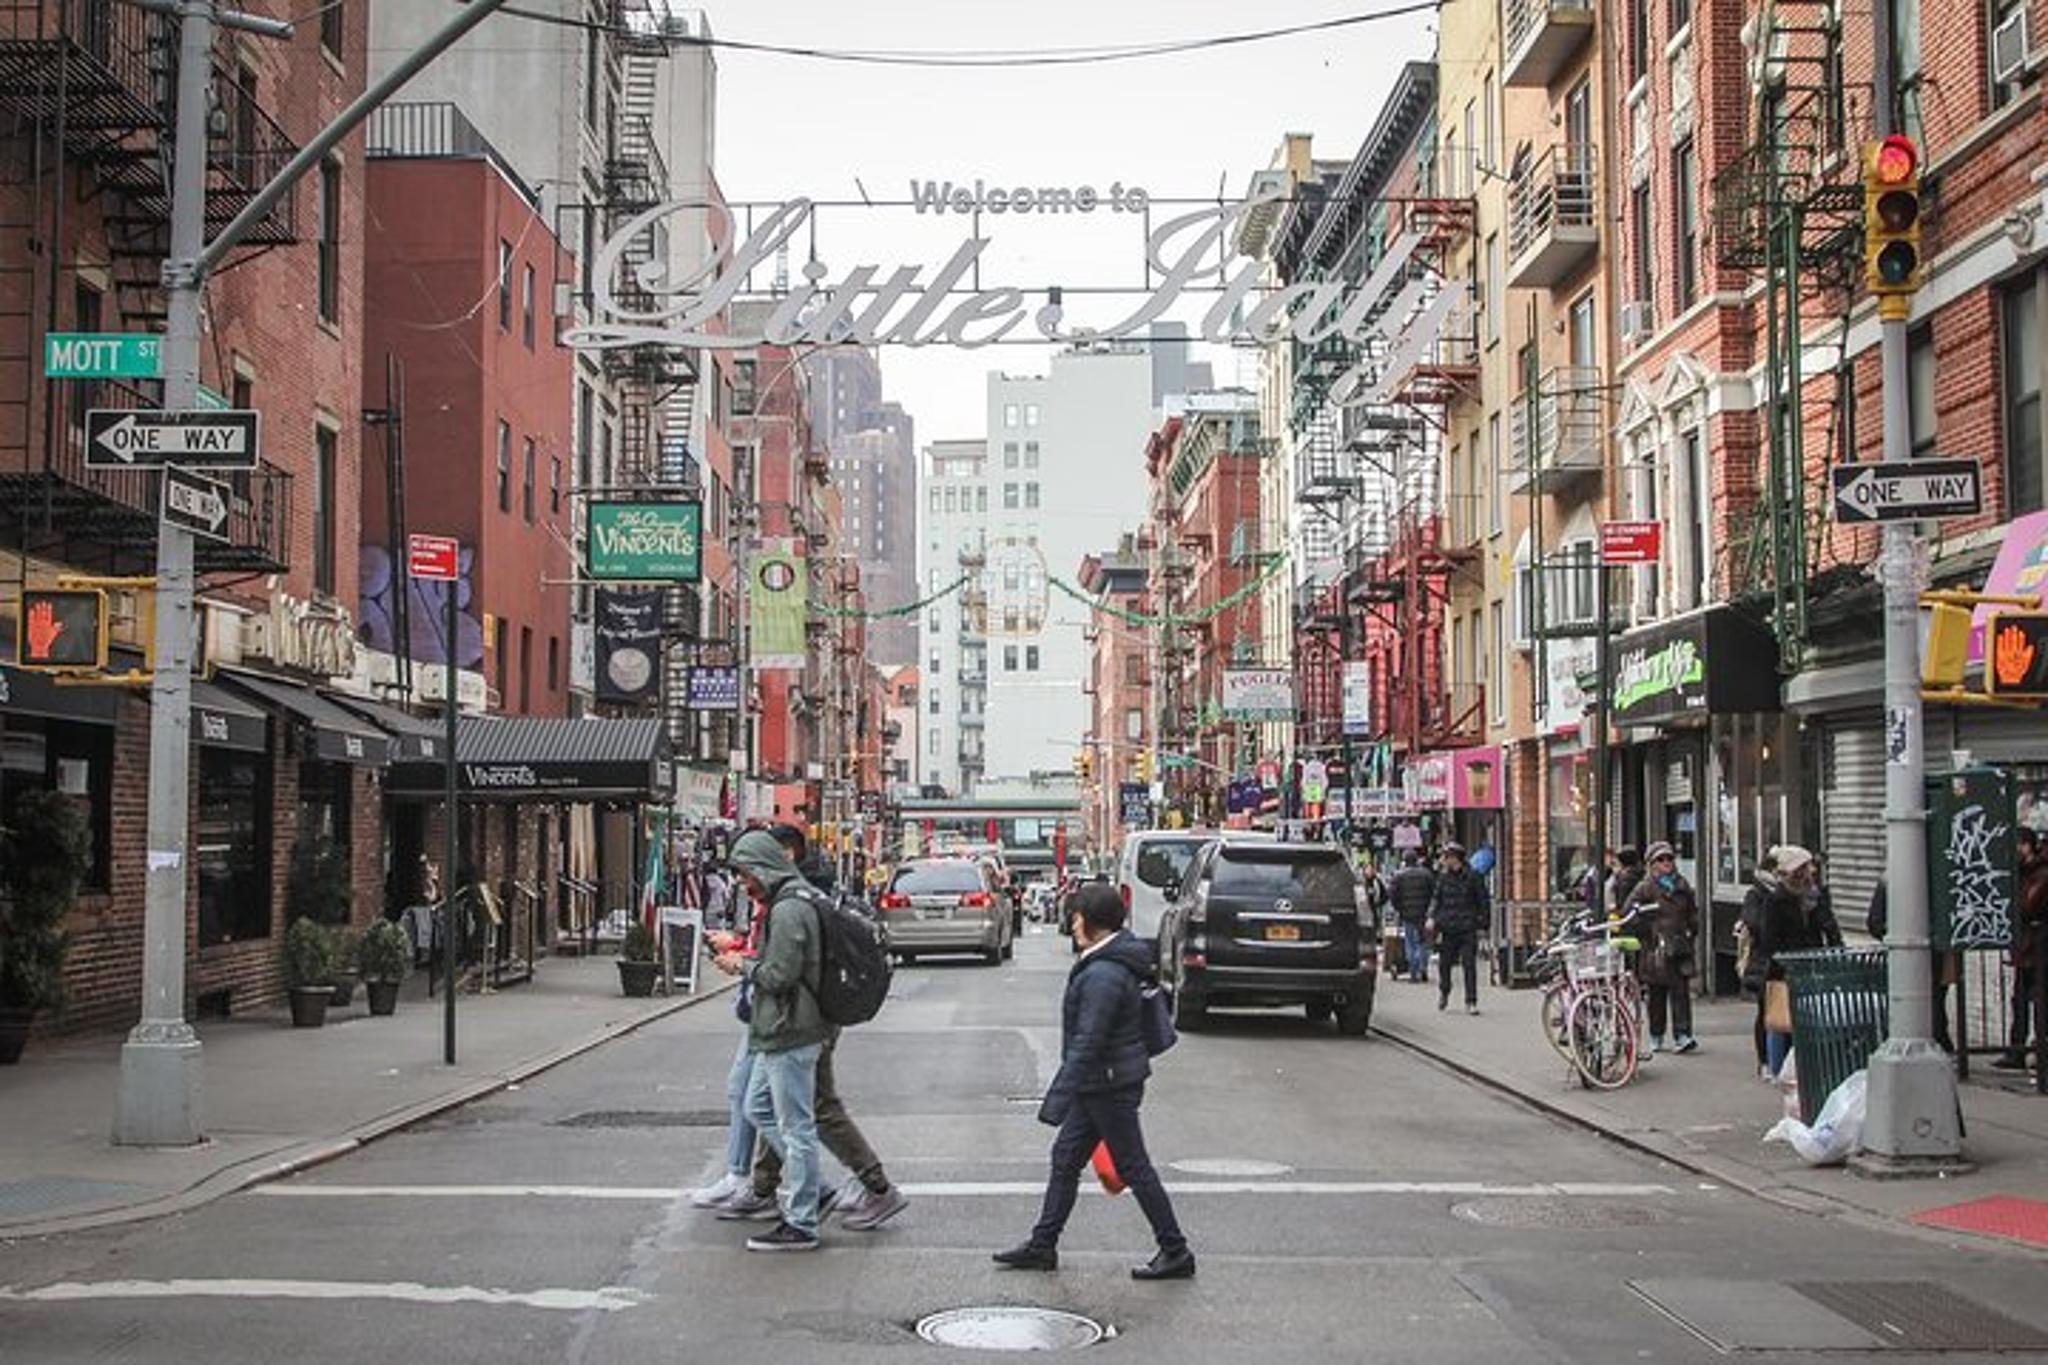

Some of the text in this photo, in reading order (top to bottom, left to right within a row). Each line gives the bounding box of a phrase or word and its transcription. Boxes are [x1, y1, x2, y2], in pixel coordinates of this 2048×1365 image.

[909, 179, 1150, 215] Welcome to
[564, 190, 1472, 405] Little Italy
[52, 340, 157, 371] MOTT ST
[113, 428, 235, 450] ONE WAY
[174, 485, 192, 511] ONE
[1855, 477, 1969, 504] ONE WAY
